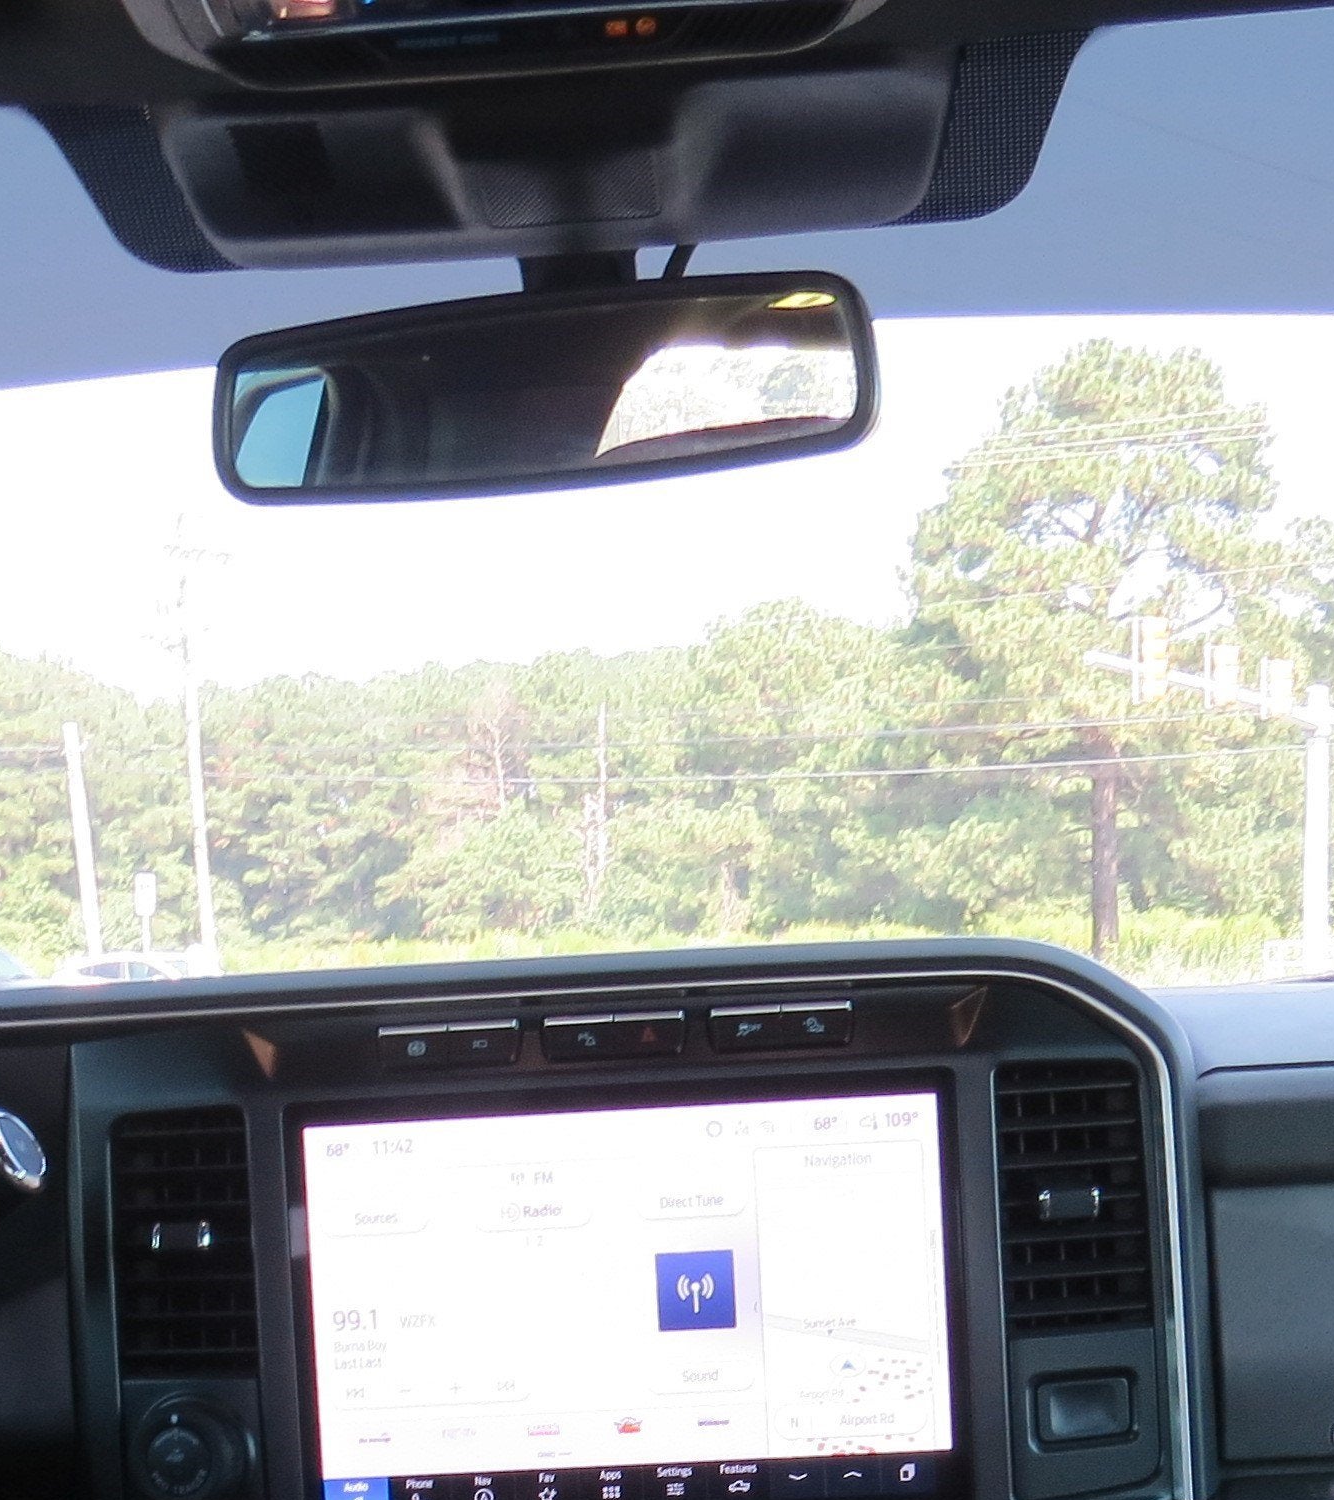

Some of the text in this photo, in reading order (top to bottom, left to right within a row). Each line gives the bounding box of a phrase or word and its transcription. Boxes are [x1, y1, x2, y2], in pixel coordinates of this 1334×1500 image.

[884, 1111, 919, 1128] 109°
[804, 1152, 872, 1169] Navigation
[533, 1171, 554, 1184] FM
[660, 1193, 724, 1209] Direct Tune
[523, 1204, 562, 1218] Radio
[332, 1309, 379, 1332] 99.1
[681, 1368, 719, 1382] Sound
[839, 1411, 895, 1428] Airport Rd
[343, 1463, 757, 1493] Audio Phone Nav Fav Apps Settings Features
